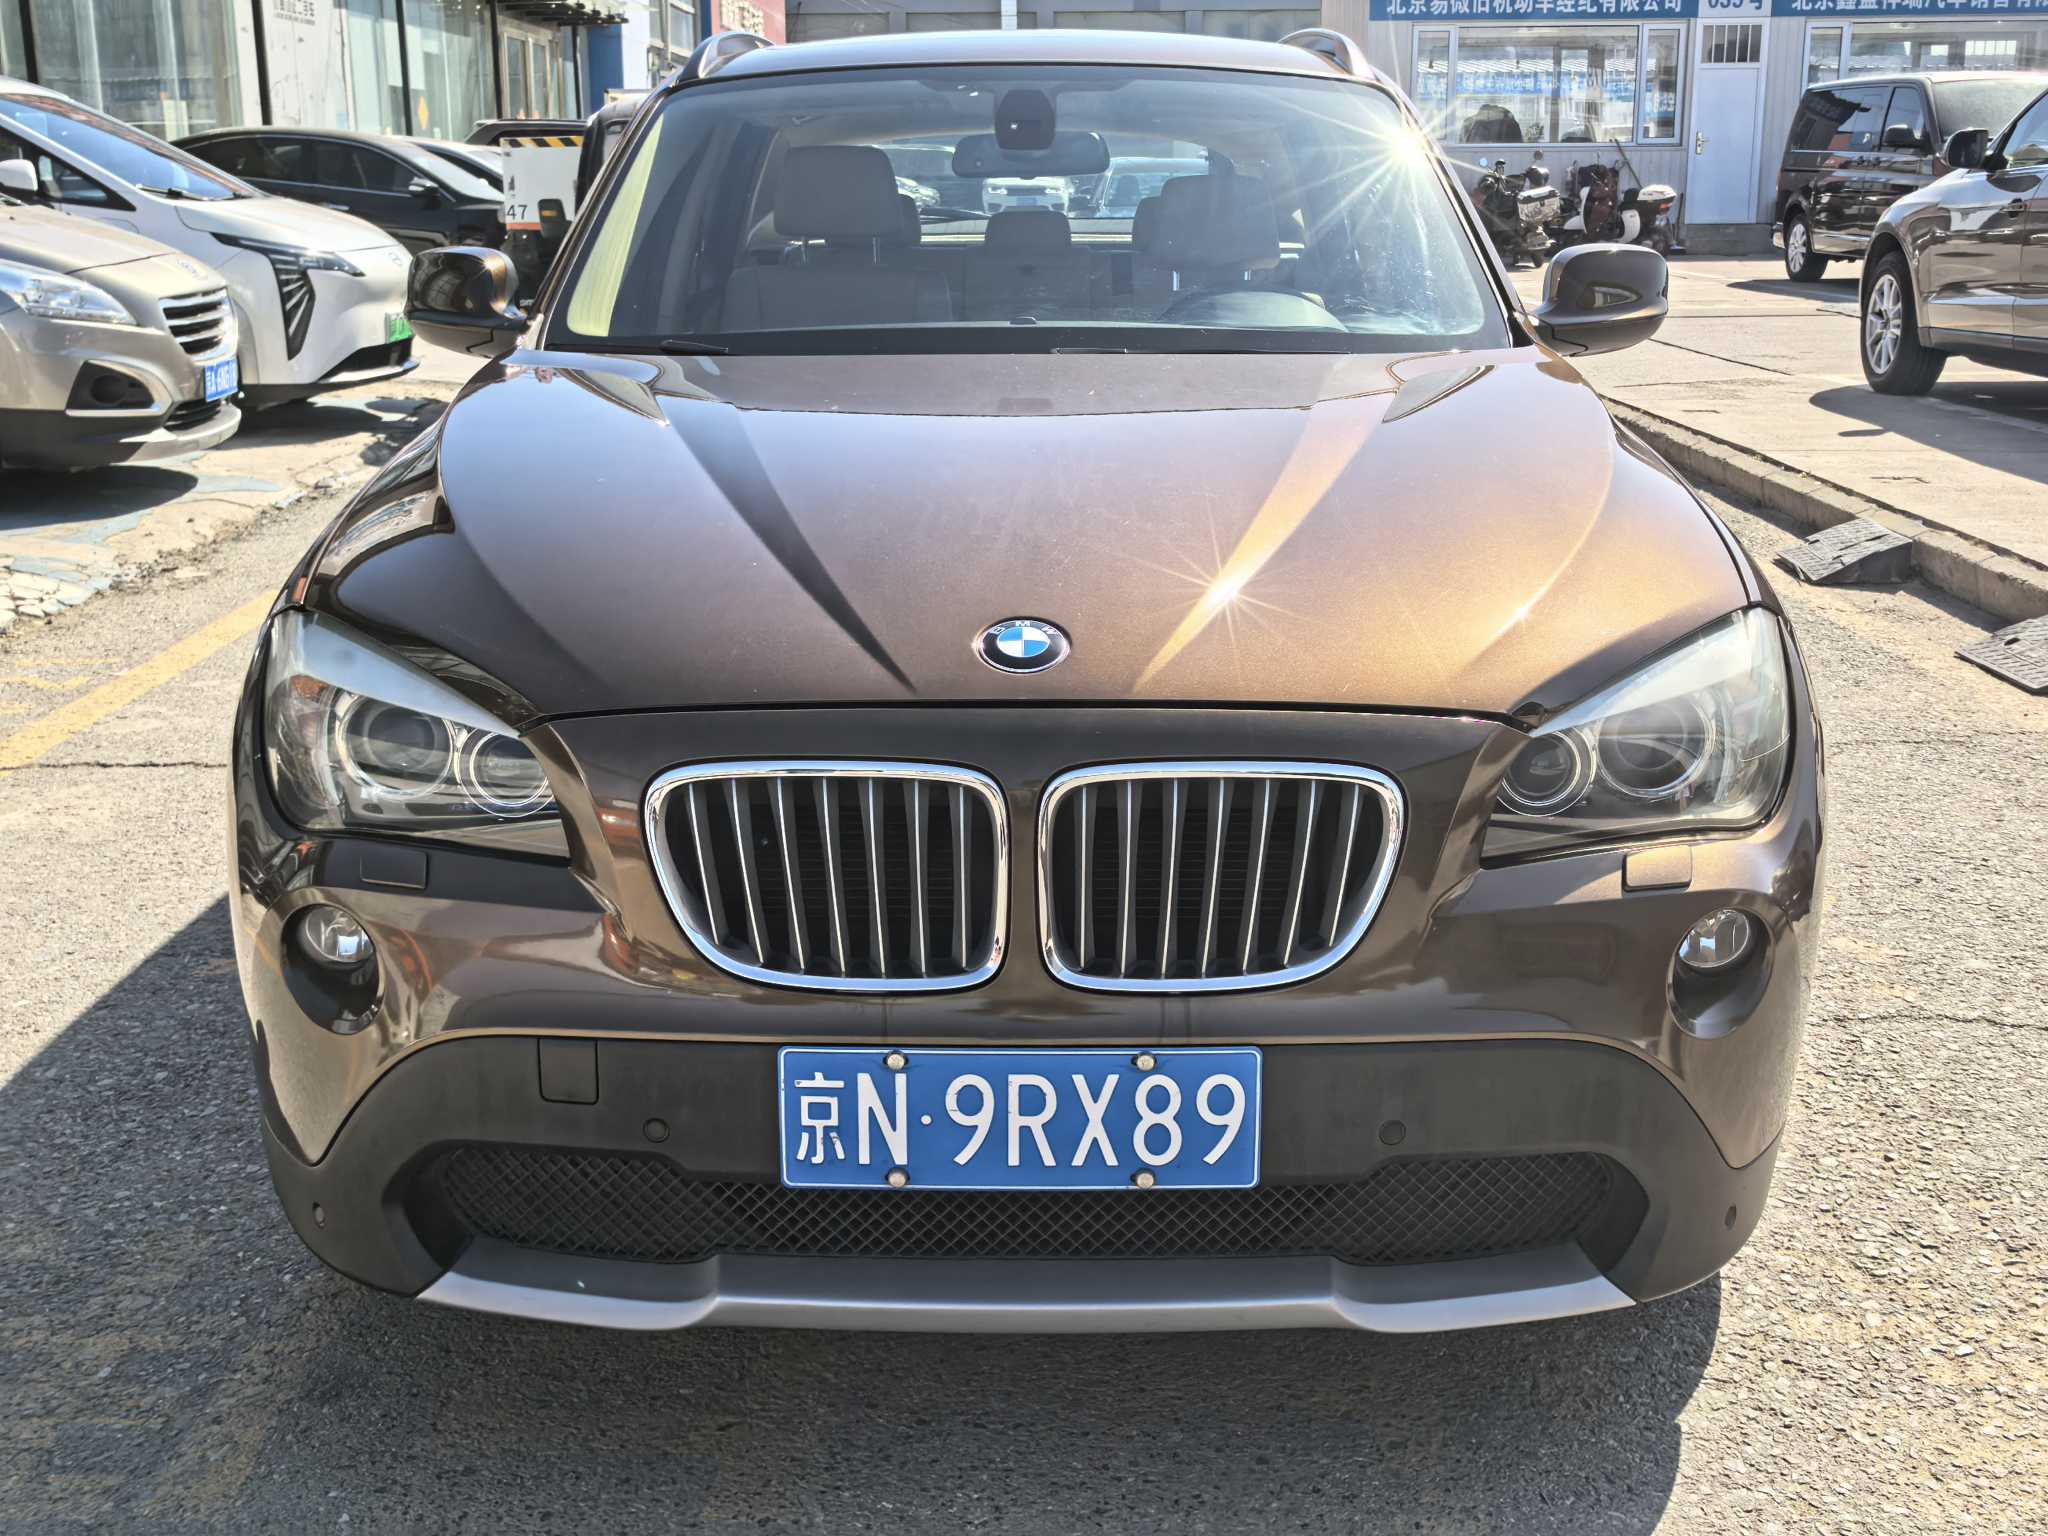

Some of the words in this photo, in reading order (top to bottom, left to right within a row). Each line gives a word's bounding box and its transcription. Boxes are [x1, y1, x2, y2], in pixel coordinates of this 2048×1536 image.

[507, 204, 528, 220] 47
[988, 620, 1058, 635] BMW
[794, 1071, 1246, 1167] 京N·9RX89
